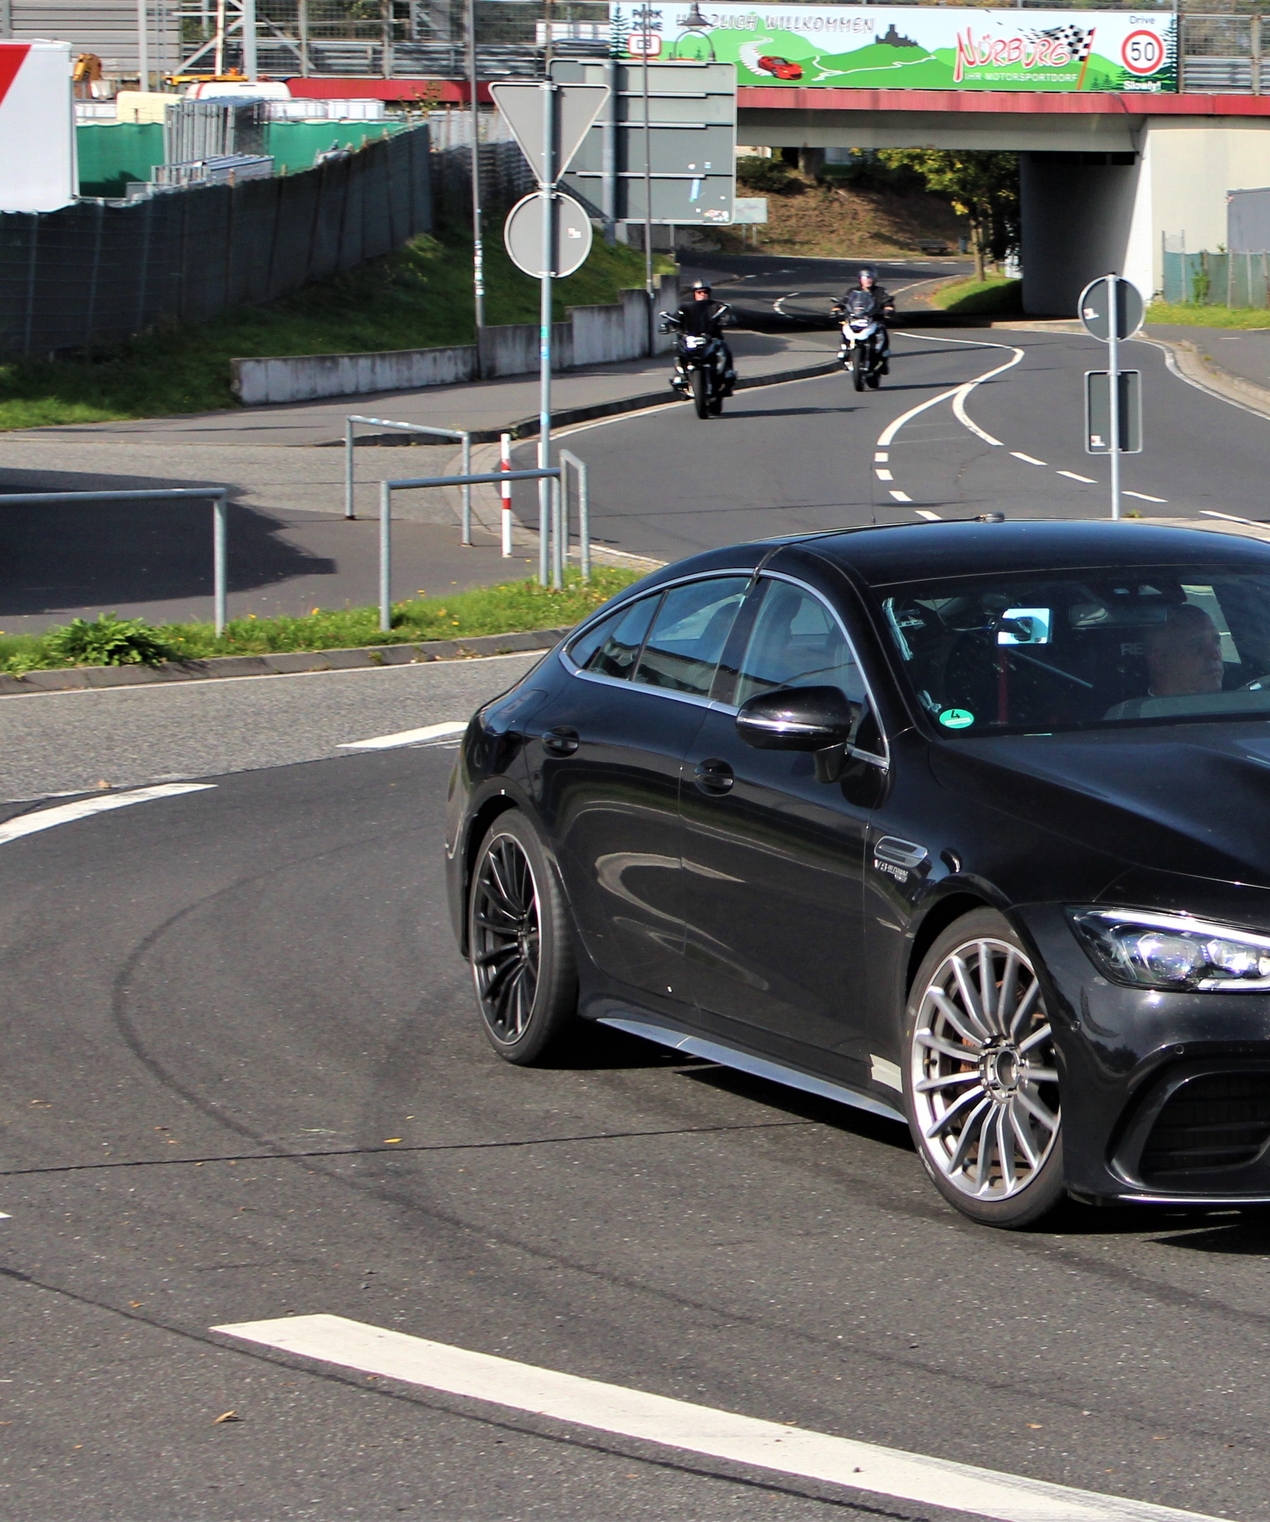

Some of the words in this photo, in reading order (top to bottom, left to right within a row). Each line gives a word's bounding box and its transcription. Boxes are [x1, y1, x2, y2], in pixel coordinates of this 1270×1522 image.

[676, 13, 758, 31] HRZLICH
[765, 15, 876, 33] WILLKOMMEN
[1129, 15, 1156, 24] Drive
[632, 22, 663, 31] ZONE
[953, 27, 1071, 83] NÜRBURG
[1130, 42, 1156, 62] 50
[965, 73, 982, 81] IHR
[985, 73, 1079, 82] MOTORSPORTDORF
[1123, 80, 1161, 92] Slowly!
[950, 709, 961, 719] 4
